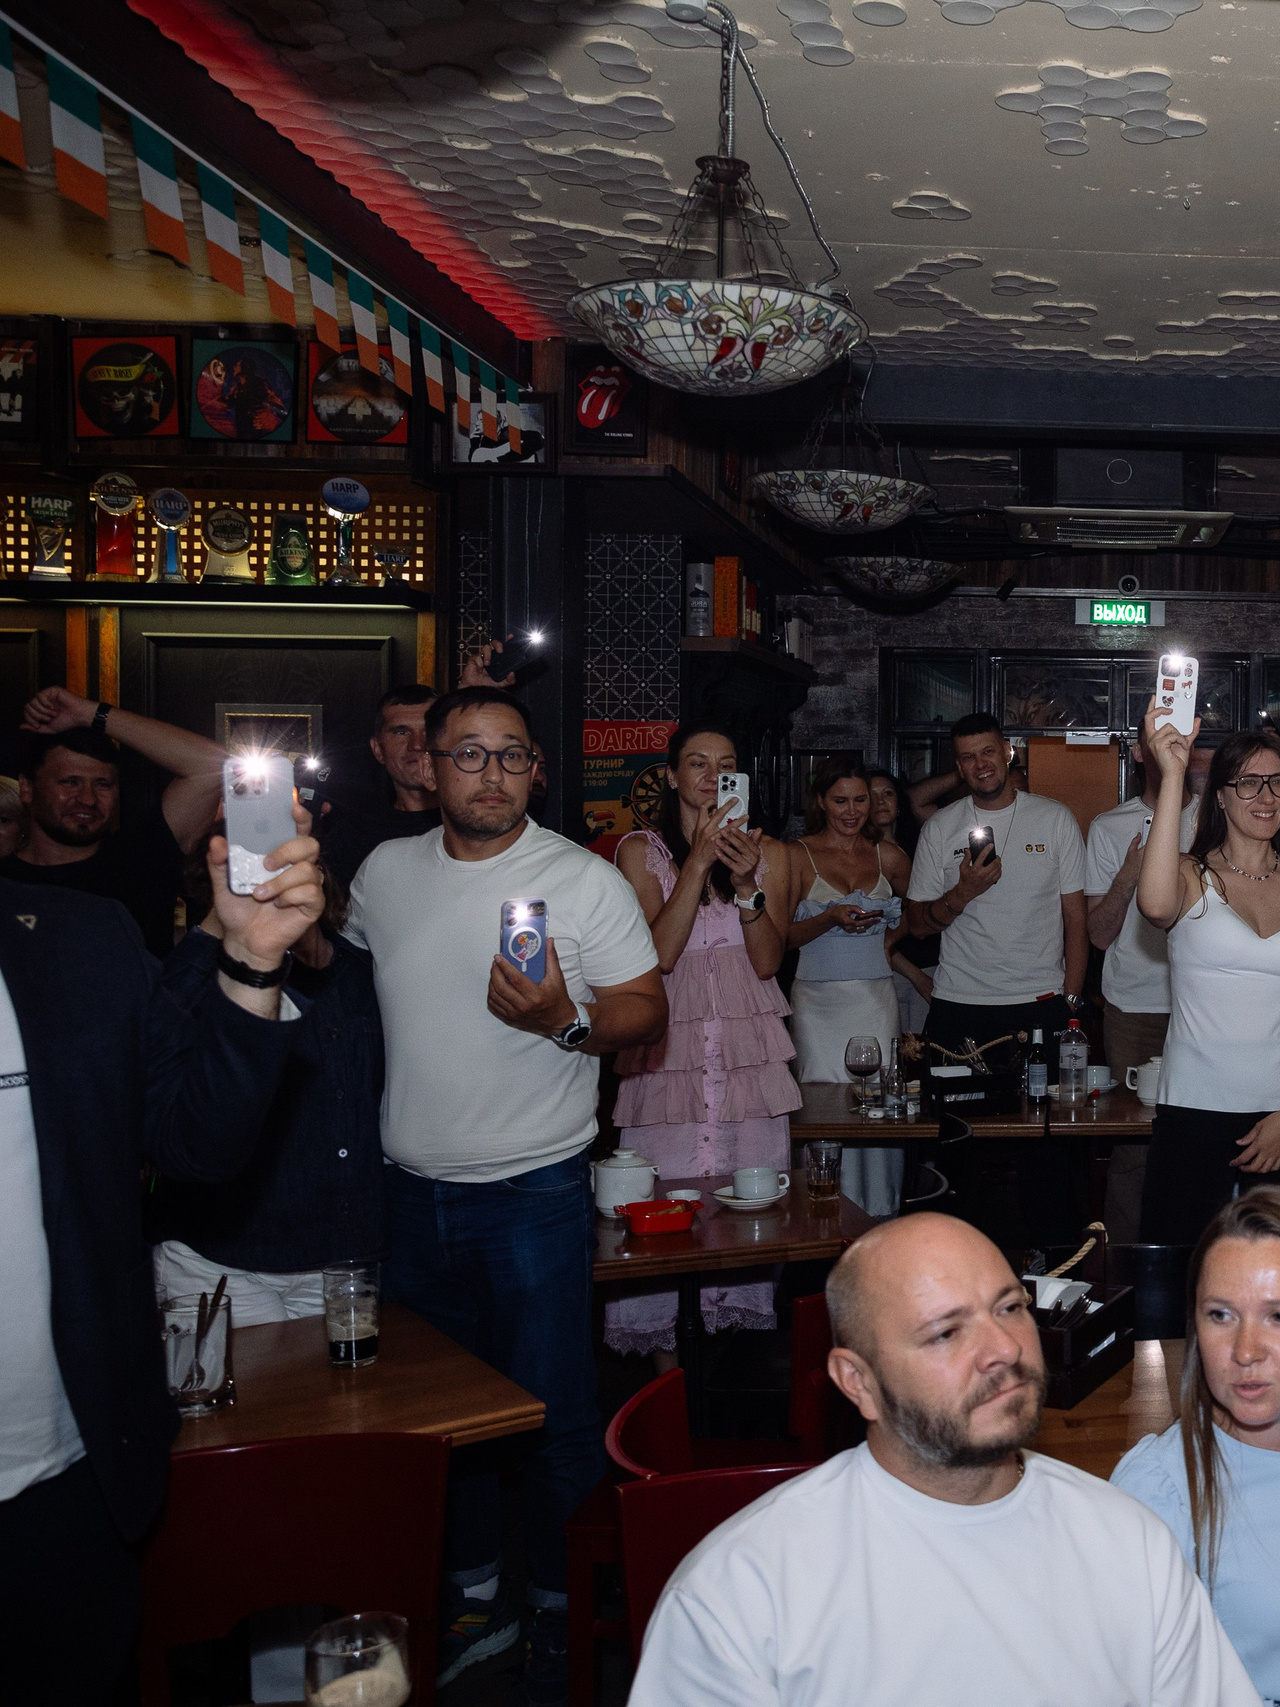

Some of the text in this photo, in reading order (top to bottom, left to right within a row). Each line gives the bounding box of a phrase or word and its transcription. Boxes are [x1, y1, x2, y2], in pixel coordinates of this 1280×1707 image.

[94, 484, 140, 495] KILKENNY
[332, 482, 360, 494] HARP
[31, 496, 73, 512] HARP
[155, 499, 189, 511] HARP
[383, 555, 407, 563] HARP
[1093, 603, 1146, 624] ВЫХОД
[583, 726, 669, 753] DARTS
[584, 758, 626, 770] ТУРНИР
[614, 769, 635, 778] СРЕДУ
[588, 780, 608, 788] 19:00
